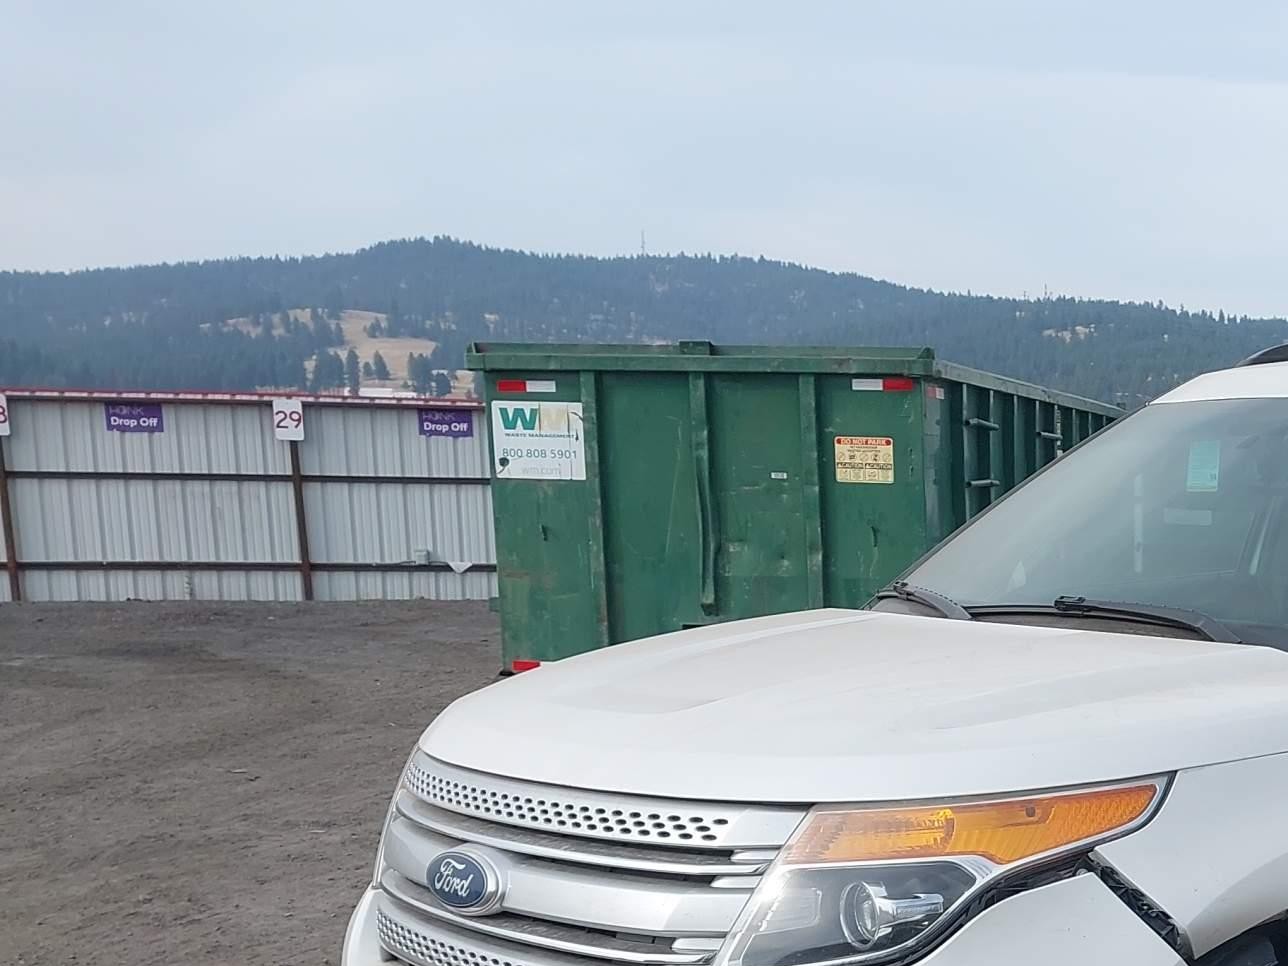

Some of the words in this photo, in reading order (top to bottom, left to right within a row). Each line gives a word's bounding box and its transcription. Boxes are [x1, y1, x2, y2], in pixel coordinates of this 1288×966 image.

[110, 416, 137, 428] Drop
[139, 417, 158, 427] Off
[275, 411, 302, 429] 29
[423, 422, 449, 433] Drop
[451, 422, 468, 432] Off
[502, 448, 523, 458] 800
[526, 448, 547, 459] 808
[550, 449, 577, 460] 5901
[435, 858, 474, 897] Ford
